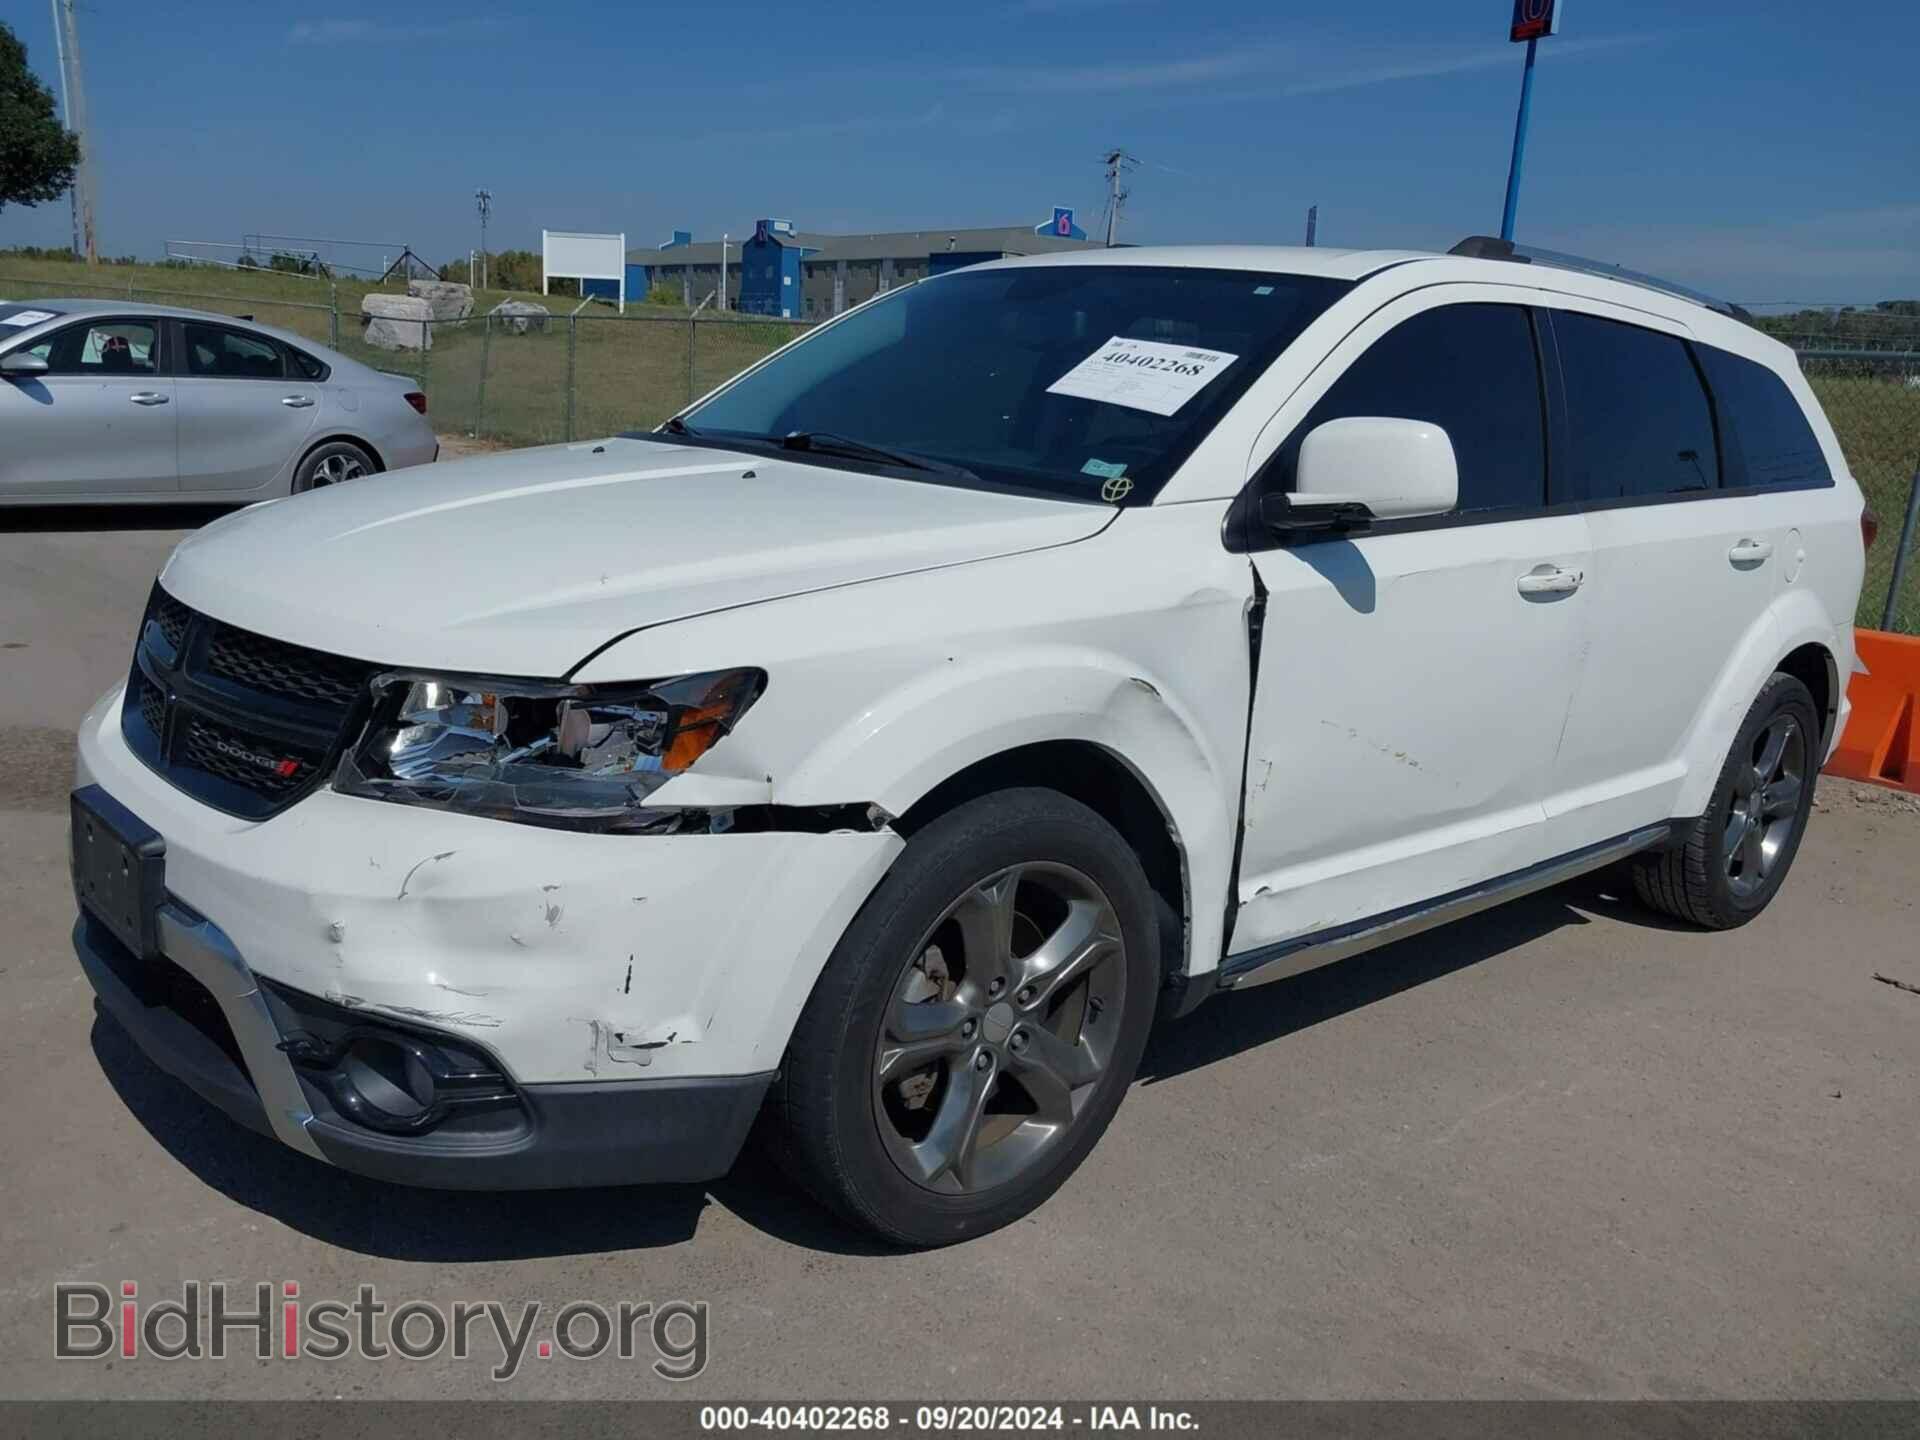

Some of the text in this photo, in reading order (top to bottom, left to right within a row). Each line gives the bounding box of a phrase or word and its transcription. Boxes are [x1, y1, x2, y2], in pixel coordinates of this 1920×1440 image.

[1058, 213, 1070, 235] 6
[1102, 351, 1205, 377] 40402268
[216, 741, 277, 769] DODGE
